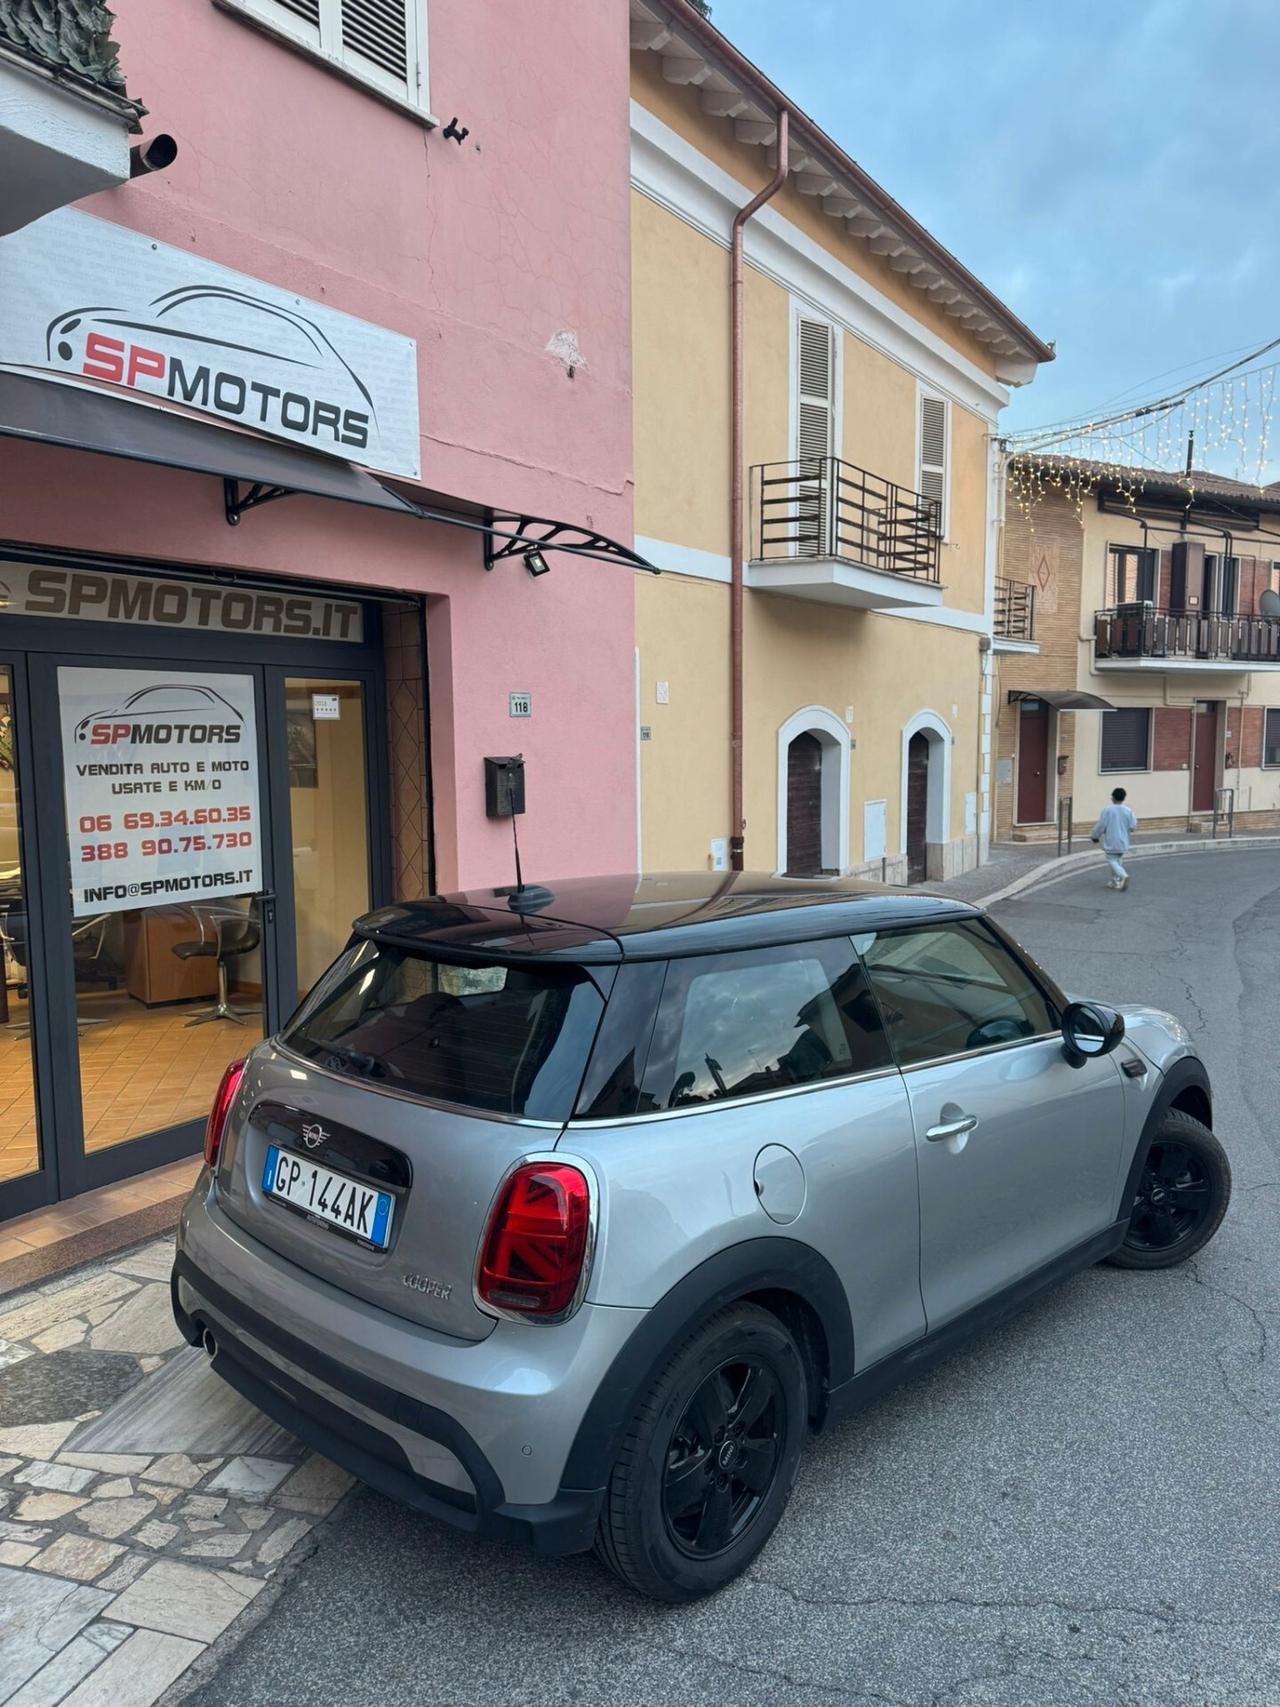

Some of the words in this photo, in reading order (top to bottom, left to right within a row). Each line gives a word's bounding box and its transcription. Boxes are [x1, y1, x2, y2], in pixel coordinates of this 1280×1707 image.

[83, 332, 369, 449] SPMOTORS
[25, 569, 358, 639] SPMOTORS.IT
[514, 701, 529, 713] 118
[90, 723, 241, 745] SPMOTORS
[76, 762, 143, 777] VENDITA
[151, 761, 190, 775] AUTO
[196, 761, 205, 772] E
[211, 760, 249, 772] MOTO
[112, 781, 162, 795] USATE
[168, 780, 178, 792] E
[79, 814, 113, 833] 06
[123, 806, 251, 830] 69.34.60.35
[80, 842, 129, 863] 388
[141, 831, 252, 857] 90.75.730
[83, 869, 253, 903] INFO@SPMOTORS.IT
[402, 1272, 452, 1301] COOPER
